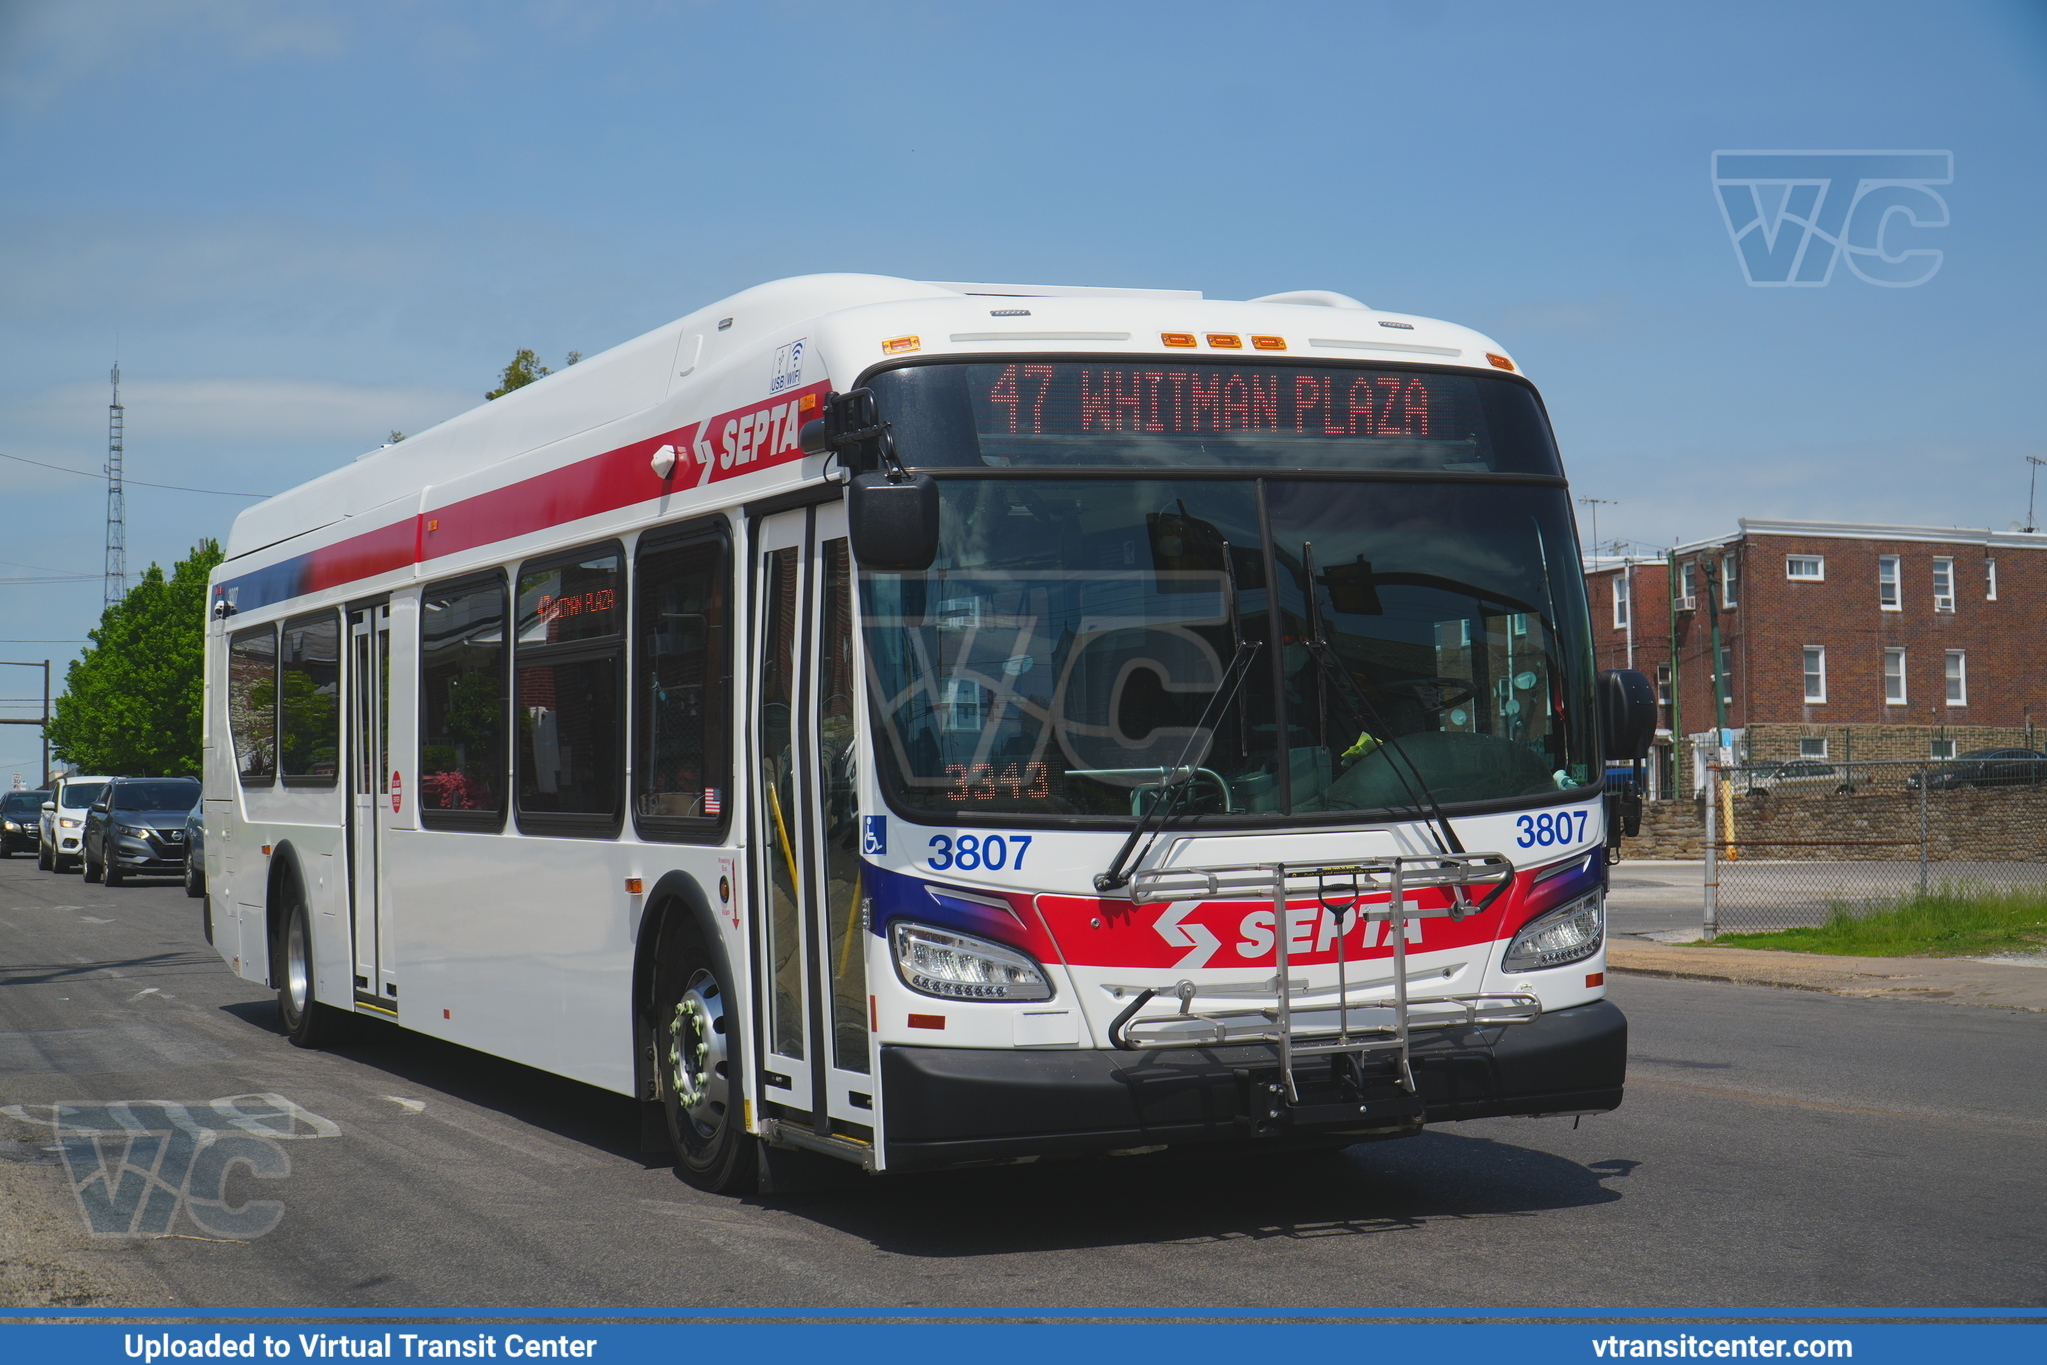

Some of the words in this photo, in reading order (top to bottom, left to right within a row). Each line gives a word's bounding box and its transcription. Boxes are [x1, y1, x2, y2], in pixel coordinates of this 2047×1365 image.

[771, 375, 785, 391] USB
[786, 369, 800, 385] WIFI
[990, 364, 1053, 434] 47
[1082, 370, 1278, 433] WHITMAN
[1295, 375, 1430, 436] PLAZA
[720, 399, 800, 470] SEPTA
[537, 595, 551, 625] 47
[585, 589, 613, 612] PLAZA
[945, 761, 1049, 801] 3343
[1516, 810, 1588, 849] 3807
[927, 834, 1033, 871] 3807
[1236, 900, 1423, 958] SEPTA
